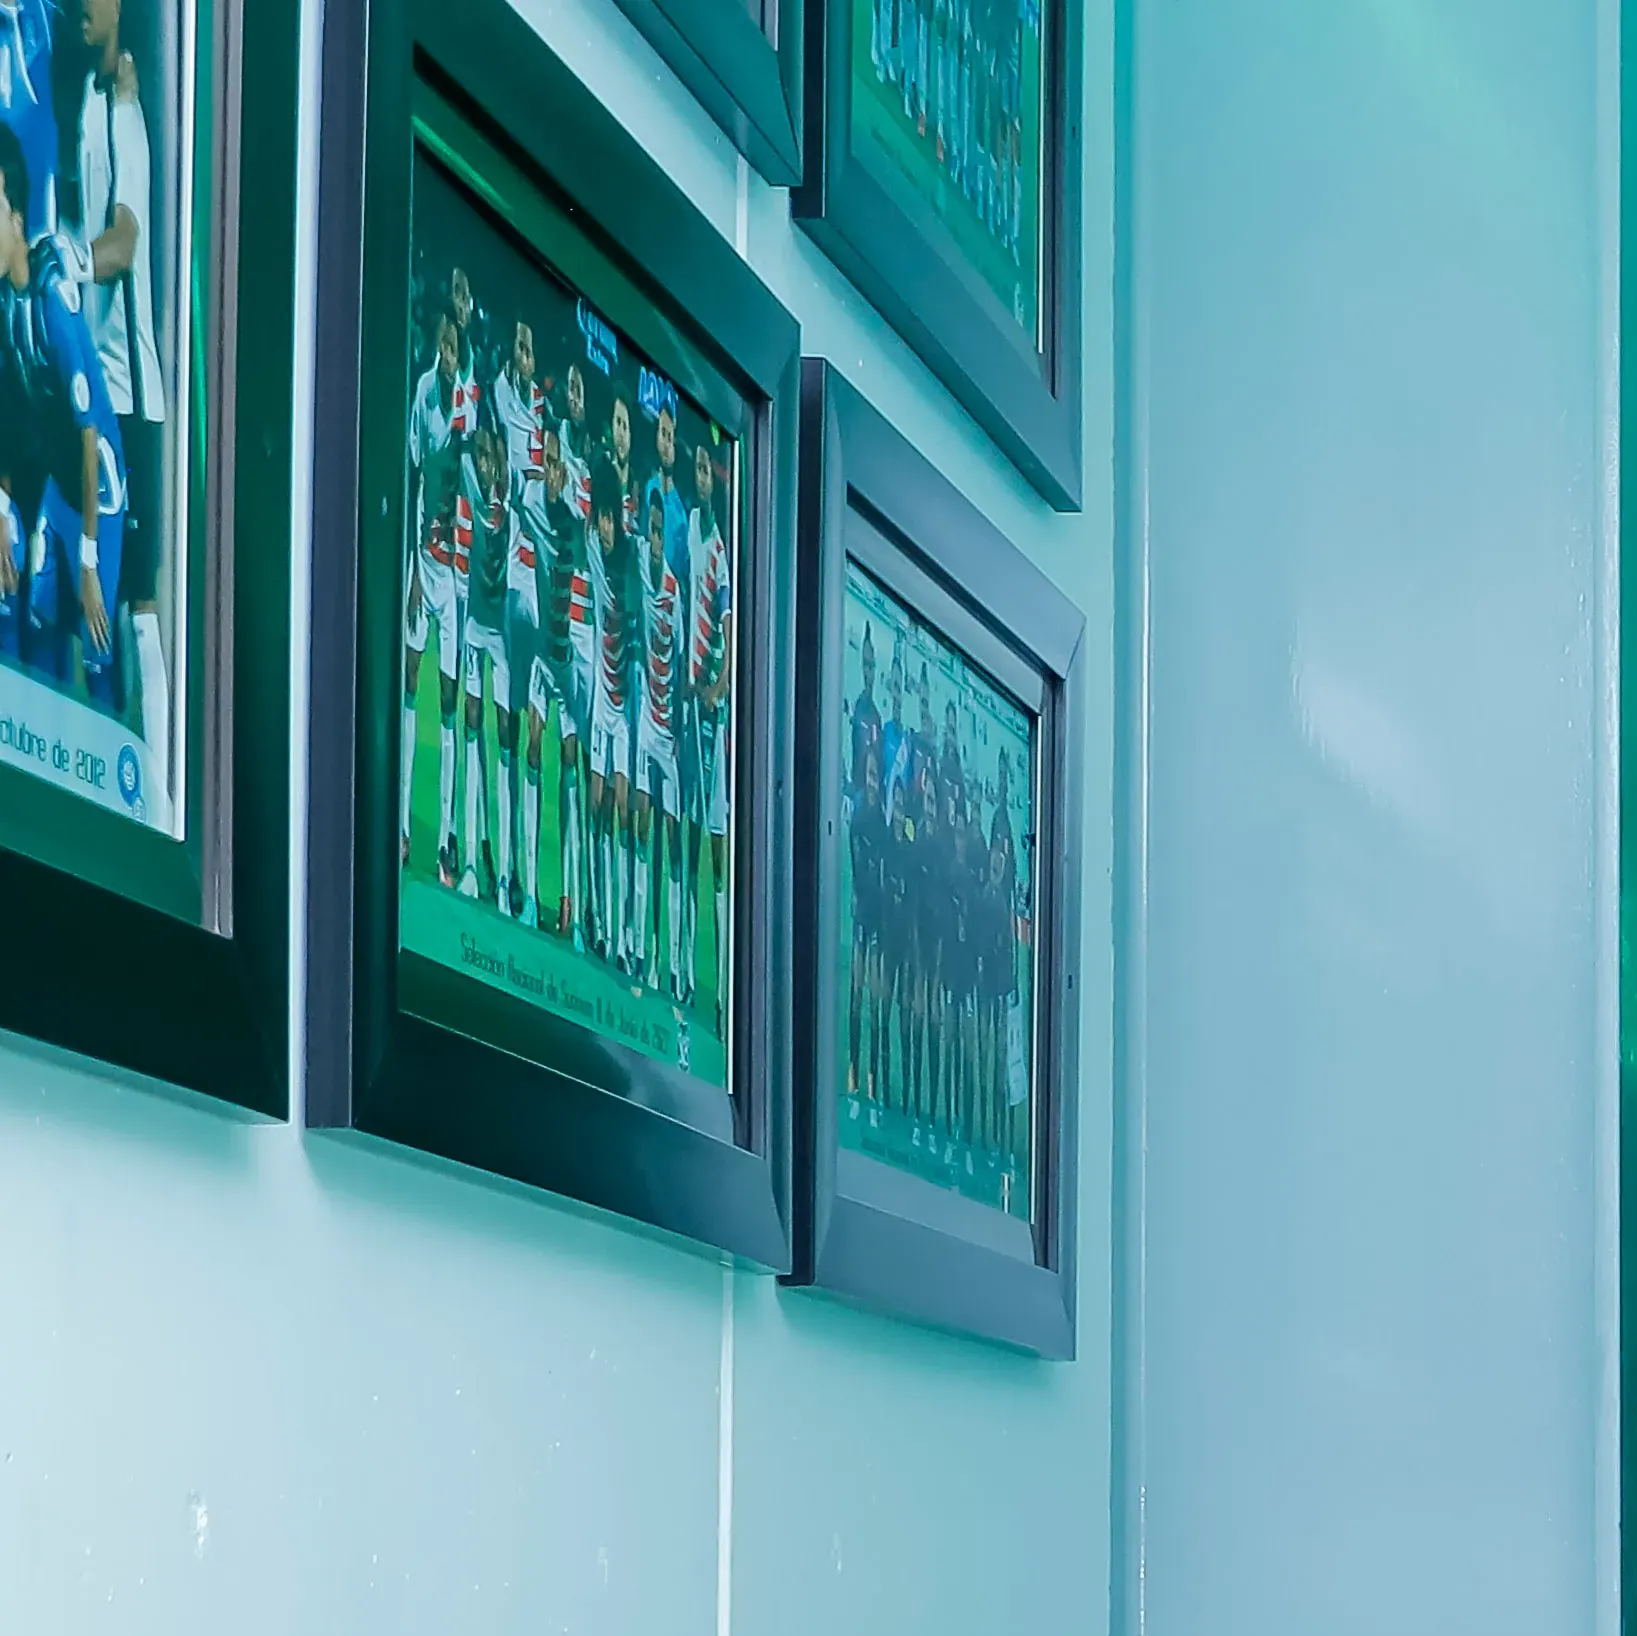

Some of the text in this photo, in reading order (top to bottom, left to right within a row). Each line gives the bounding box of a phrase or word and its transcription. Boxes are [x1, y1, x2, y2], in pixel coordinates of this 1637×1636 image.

[0, 717, 107, 790] ctubre de 2012
